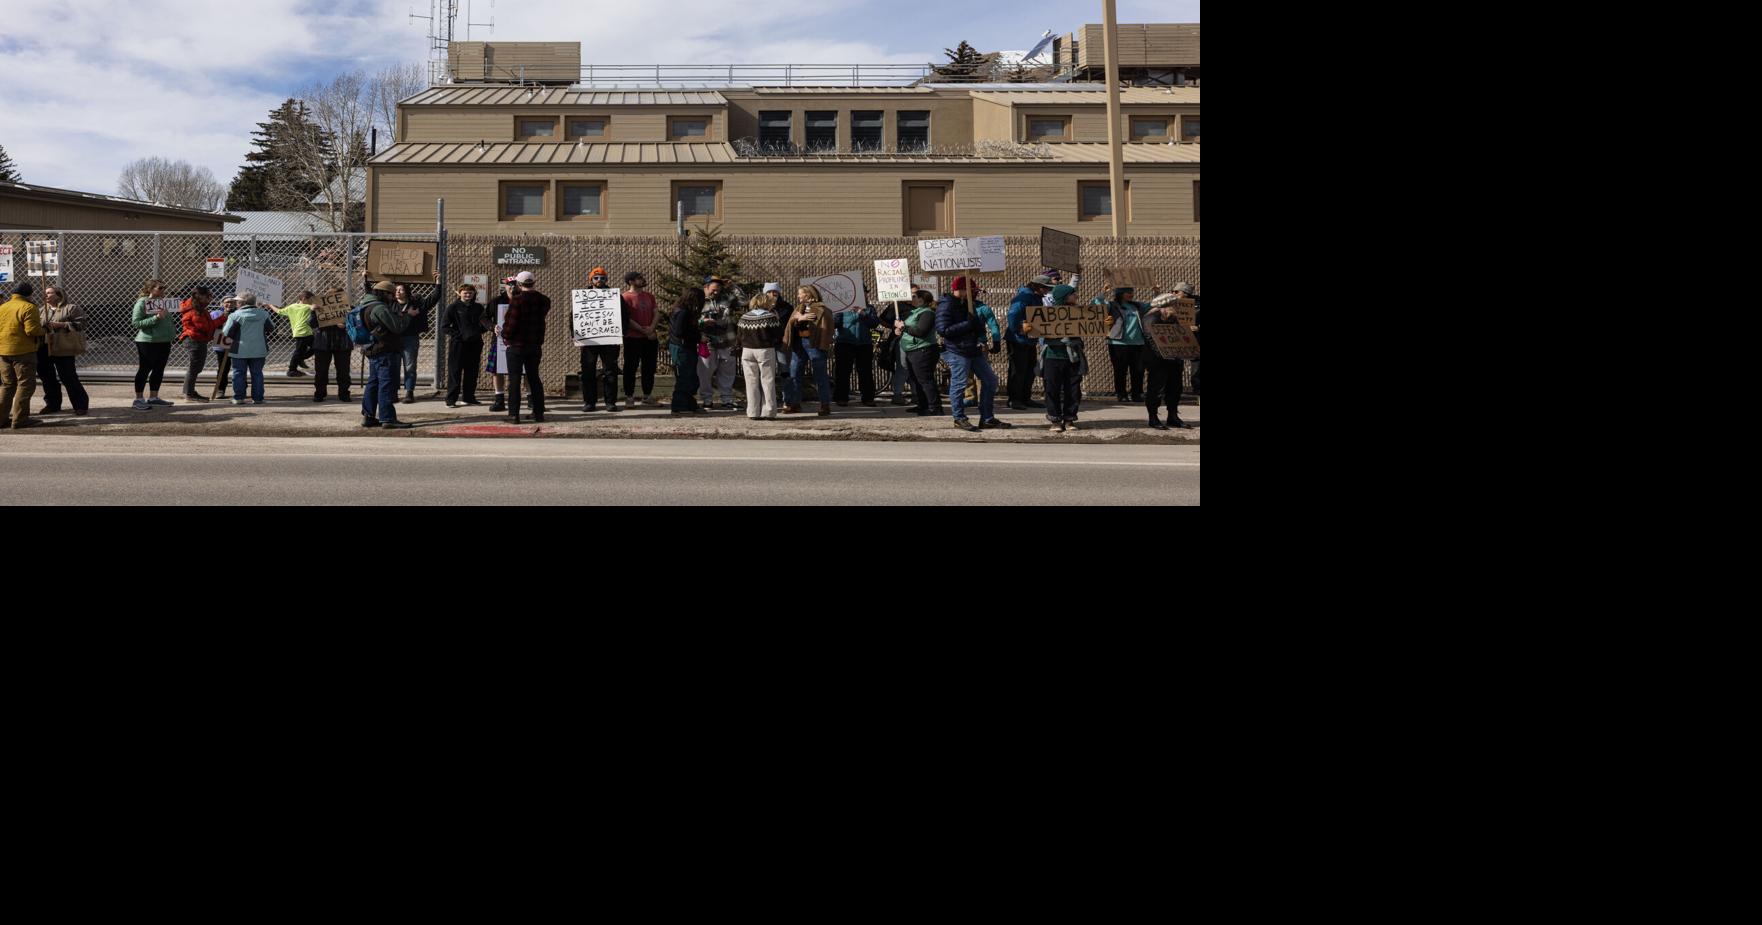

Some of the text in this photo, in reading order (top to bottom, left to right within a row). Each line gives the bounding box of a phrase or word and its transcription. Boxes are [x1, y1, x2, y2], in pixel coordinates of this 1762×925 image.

[924, 239, 969, 250] DEPORT
[924, 258, 982, 270] NATIONALISTS
[321, 293, 342, 306] ICE
[575, 290, 617, 300] ABOLISH
[581, 301, 604, 309] ICE
[574, 311, 614, 319] FASCISM
[1031, 306, 1105, 322] ABOLISH
[574, 326, 620, 338] REFORMED
[1040, 321, 1105, 336] ICE NOW
[216, 332, 233, 346] IC
